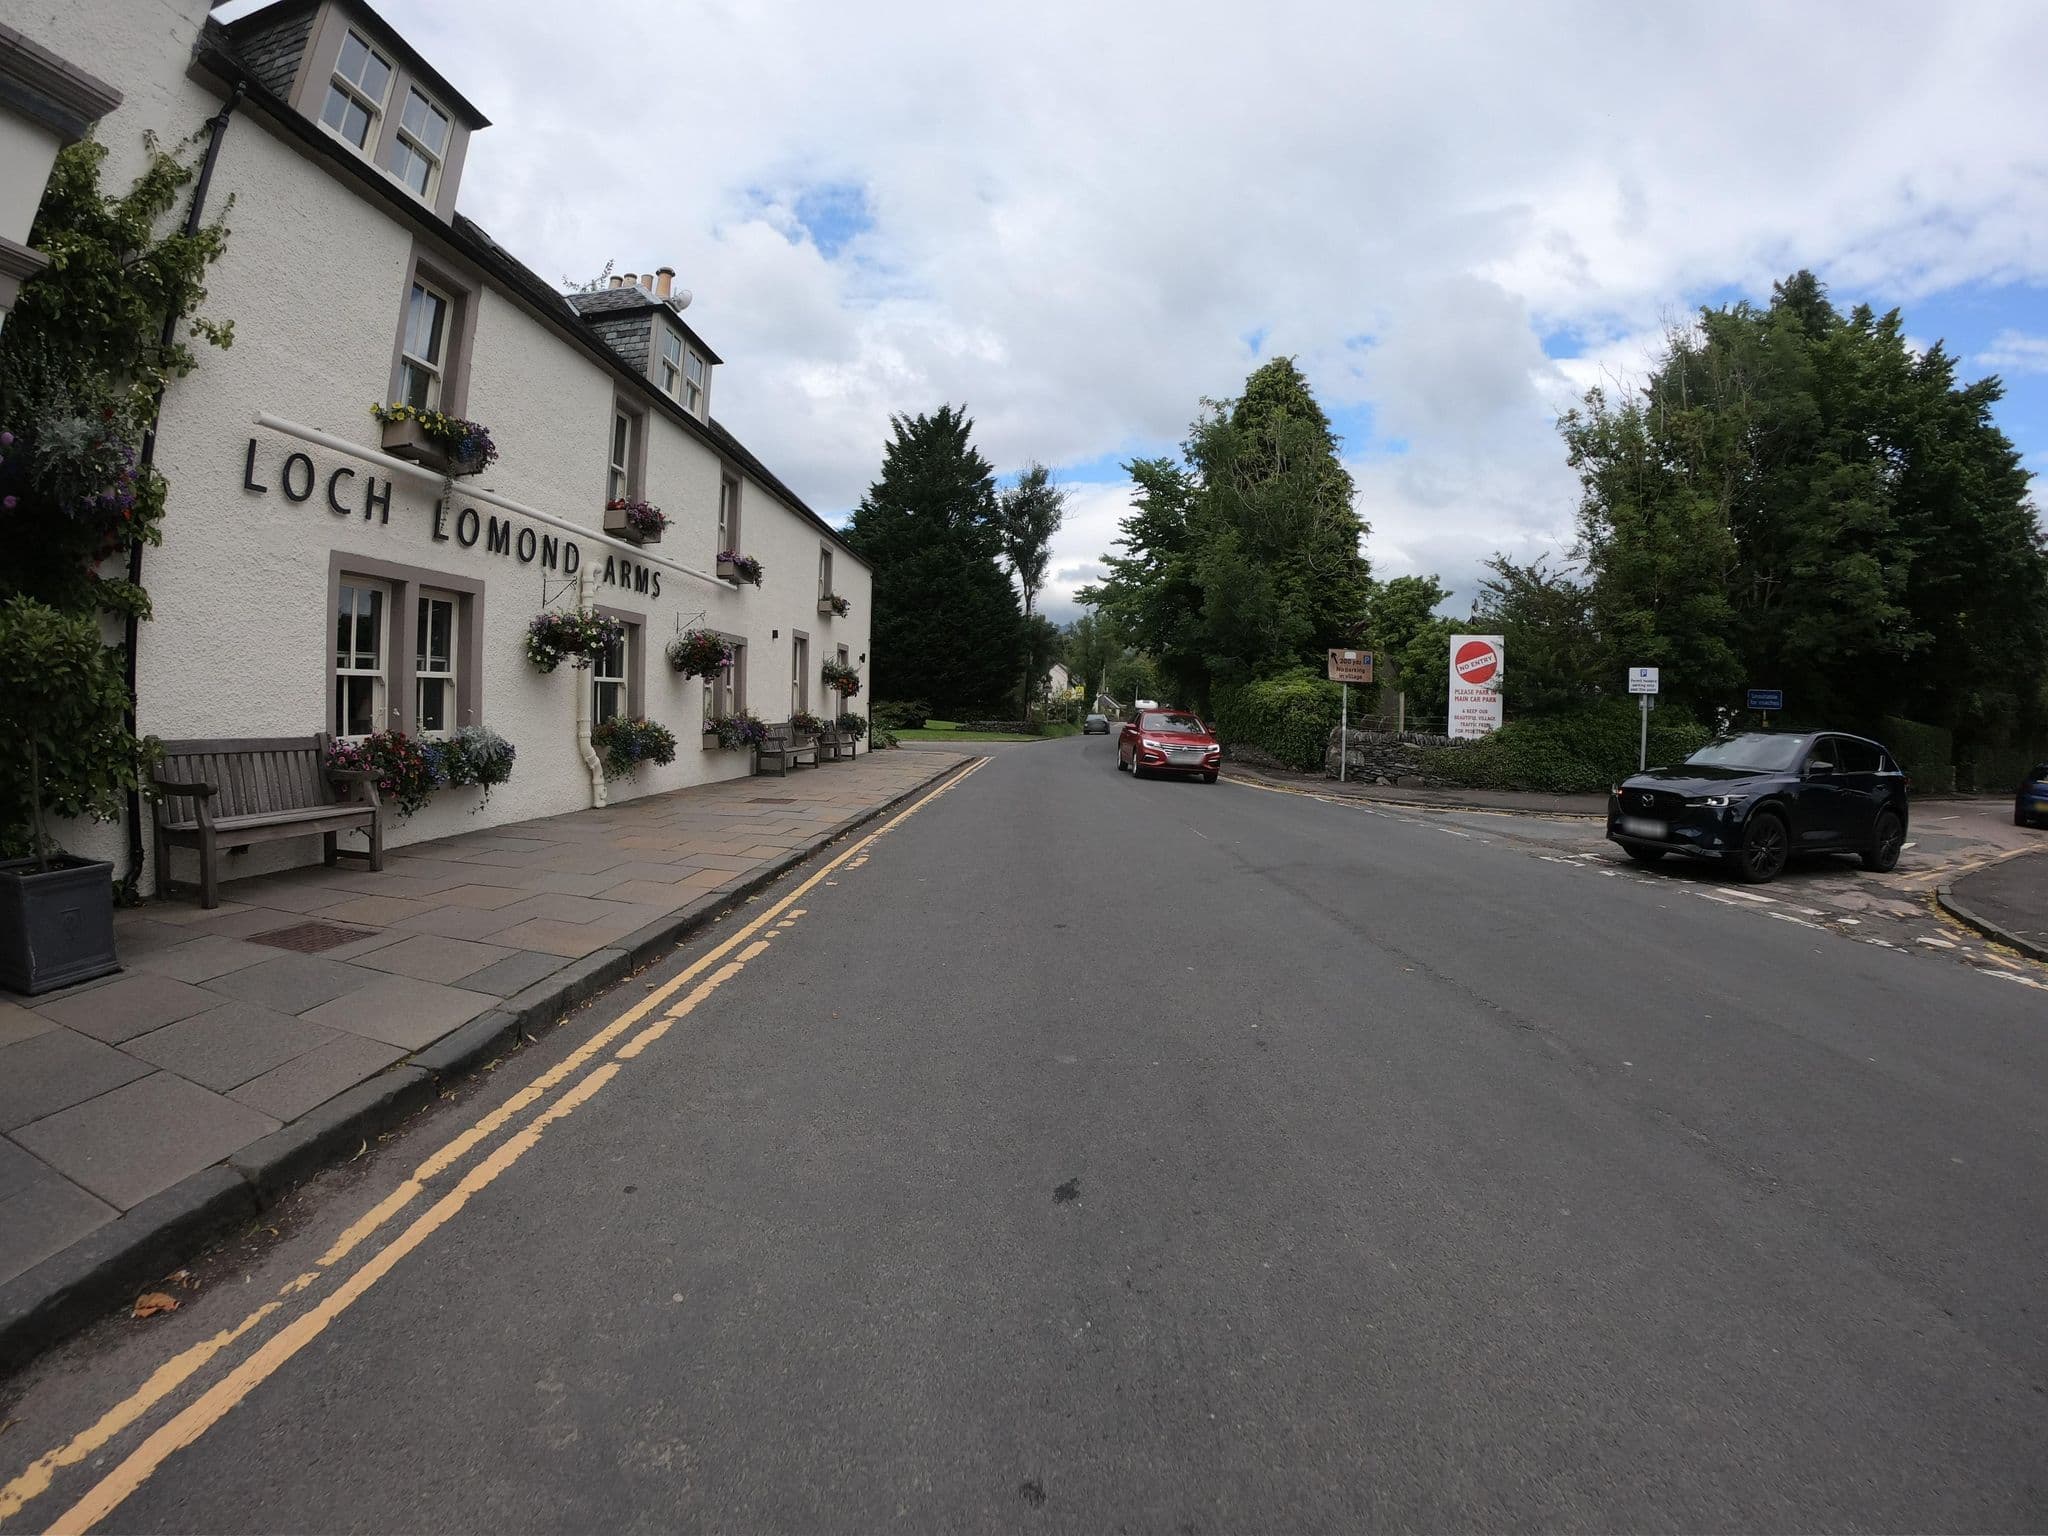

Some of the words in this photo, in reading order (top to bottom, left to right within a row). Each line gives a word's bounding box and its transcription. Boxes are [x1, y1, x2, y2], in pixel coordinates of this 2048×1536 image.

[243, 438, 392, 525] LOCH
[432, 500, 580, 574] LOMOND
[603, 555, 661, 598] ARMS
[1471, 655, 1492, 668] ENTRY
